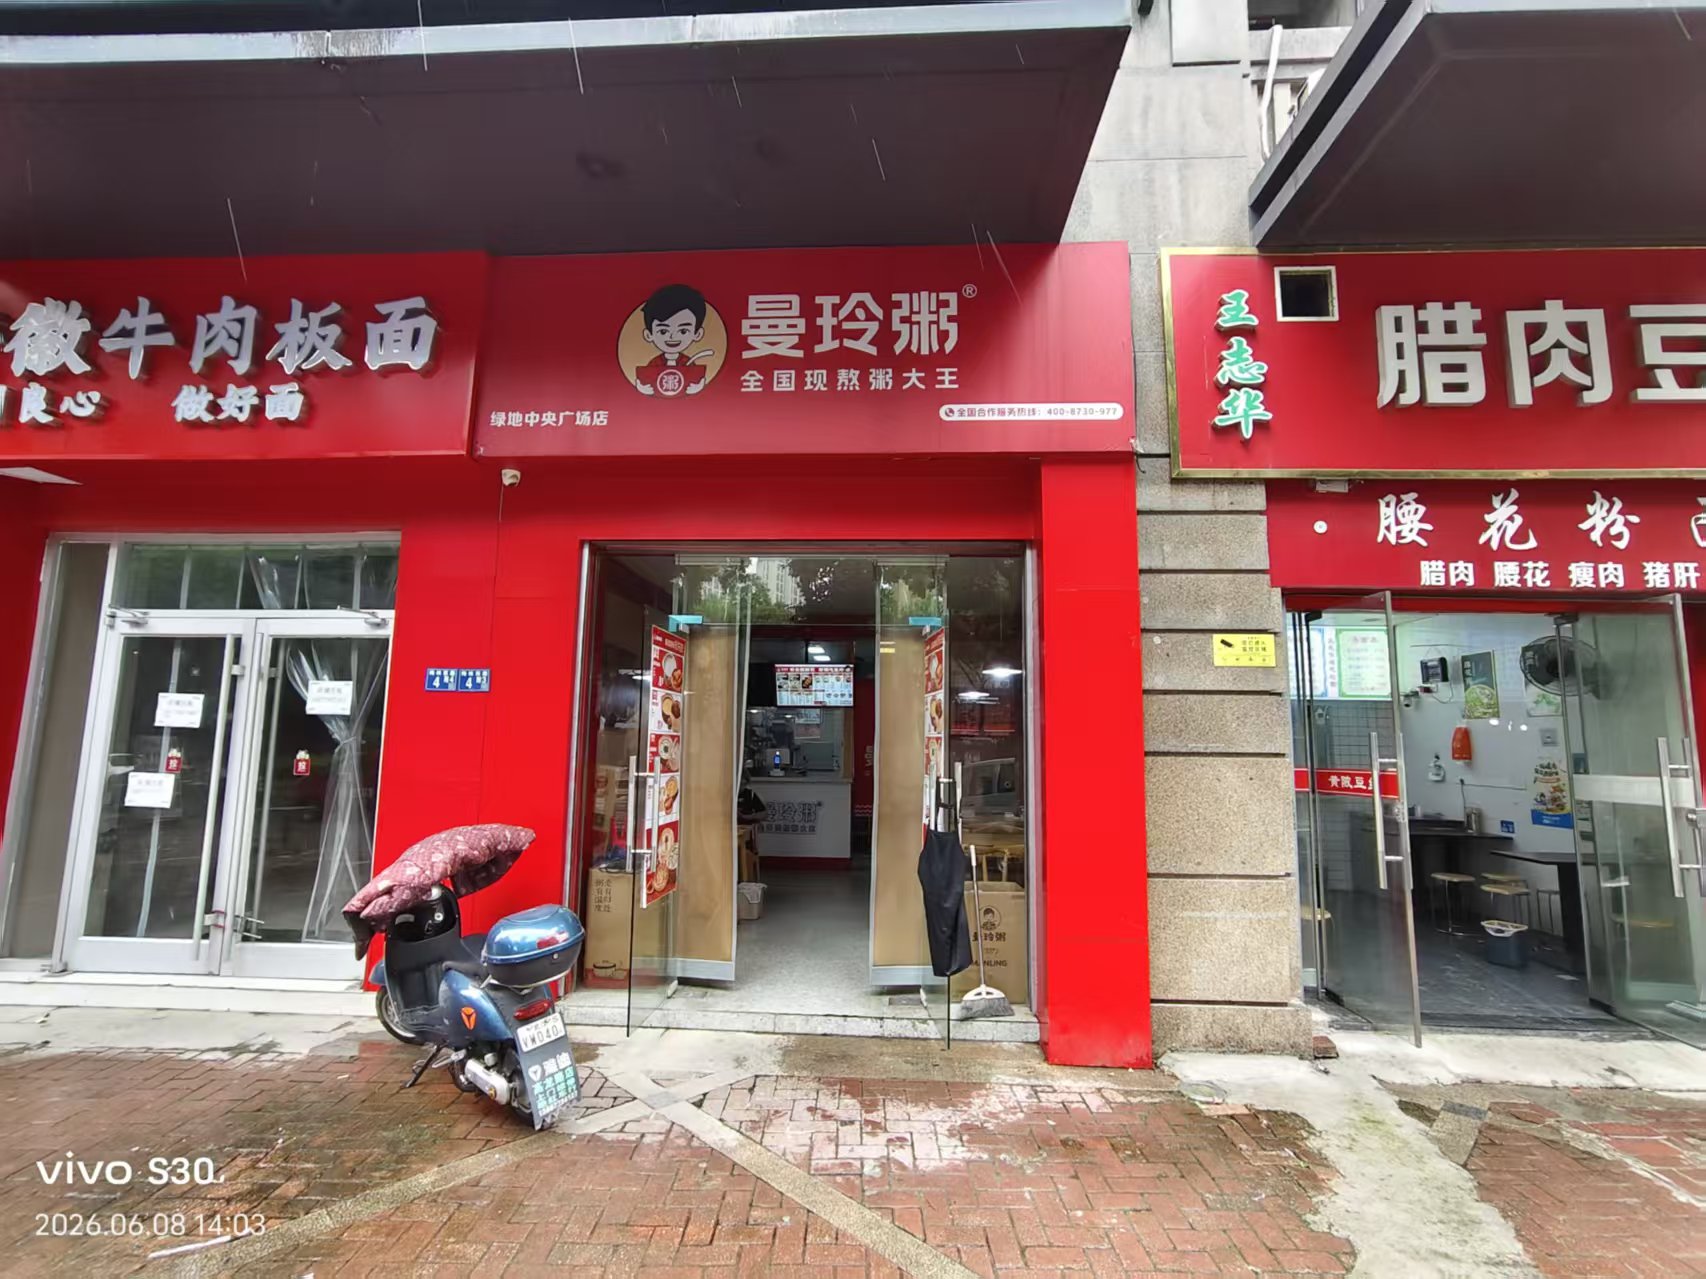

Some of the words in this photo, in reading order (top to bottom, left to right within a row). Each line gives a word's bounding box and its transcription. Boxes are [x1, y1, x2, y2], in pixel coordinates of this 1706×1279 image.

[740, 290, 960, 358] 曼玲粥
[740, 367, 960, 393] 全国现熬粥大王
[1213, 288, 1273, 442] 王志华
[0, 381, 102, 424] 良心
[171, 381, 305, 423] 做好面
[490, 410, 609, 427] 绿地中央广场店
[1420, 560, 1475, 588] 腊肉
[1494, 560, 1550, 588] 腰花
[1568, 560, 1625, 589] 瘦肉
[1643, 560, 1700, 589] 猪肝
